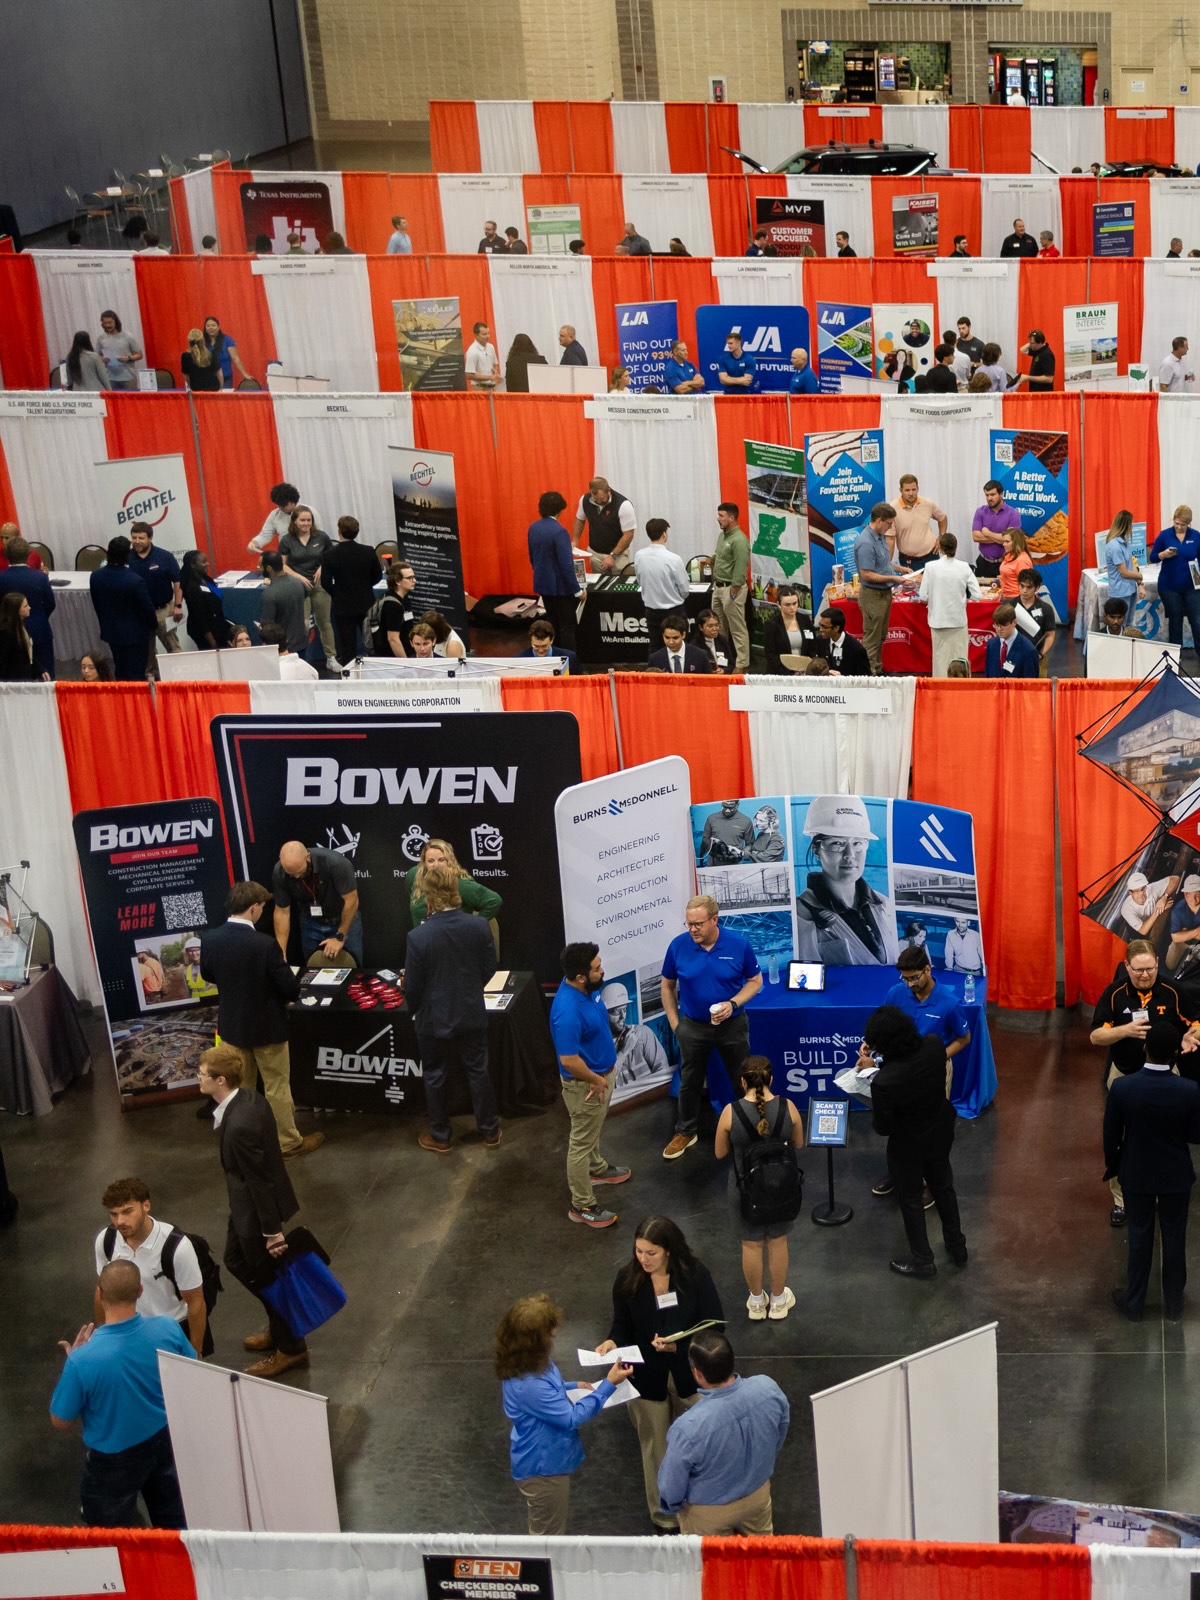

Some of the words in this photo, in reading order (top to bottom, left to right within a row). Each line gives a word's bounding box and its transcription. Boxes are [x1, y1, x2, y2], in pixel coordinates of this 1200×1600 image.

[259, 190, 278, 199] TEXAS
[280, 191, 322, 199] INSTRUMENTS
[785, 205, 811, 214] MVP
[770, 226, 812, 236] CUSTOMER
[773, 234, 811, 243] FOCUSED.
[427, 305, 454, 313] KELLER
[1075, 309, 1106, 319] BRAUN
[621, 311, 649, 327] LJA
[821, 310, 846, 326] LJA
[1075, 318, 1106, 328] INTERTEC
[623, 340, 648, 351] FIND
[649, 338, 673, 349] OUT
[623, 352, 649, 363] WHY
[821, 357, 853, 366] ENGINEERING
[625, 365, 640, 374] OF
[642, 362, 666, 372] OUR
[607, 406, 627, 414] MESSER
[909, 407, 925, 415] MCKEE
[941, 406, 972, 416] CORPORATION
[409, 467, 436, 482] BECHTEL
[837, 467, 852, 477] Join
[1013, 471, 1020, 480] A
[1021, 471, 1047, 482] Better
[829, 475, 863, 486] America's
[819, 485, 848, 495] Favorite
[849, 483, 873, 493] Family
[1016, 481, 1034, 493] Way
[1034, 483, 1044, 492] to
[833, 494, 860, 503] Bakery.
[1002, 490, 1017, 500] Live
[1018, 492, 1034, 501] and
[1035, 493, 1059, 503] Work.
[117, 488, 177, 525] BECHTEL
[405, 520, 436, 532] Extraordinary
[399, 527, 418, 536] building
[417, 529, 438, 539] inspiring
[437, 532, 458, 541] projects.
[337, 698, 363, 707] BOWEN
[364, 698, 411, 707] ENGINEERING
[411, 697, 461, 707] CORPORATION
[774, 695, 798, 704] BURNS
[798, 695, 804, 704] &
[805, 695, 847, 704] MCDONNELL
[284, 762, 518, 811] BOWEN
[573, 806, 607, 825] BURNS
[90, 818, 214, 852] BOWEN
[598, 832, 661, 860] ENGINEERING
[107, 863, 159, 876] CONSTRUCTION
[159, 857, 206, 869] MANAGEMENT
[118, 870, 161, 881] MECHANICAL
[161, 864, 198, 875] ENGINEERS
[472, 868, 509, 877] Results.
[596, 853, 666, 884] ARCHITECTURE
[132, 878, 149, 887] CIVIL
[150, 873, 186, 884] ENGINEERS
[125, 883, 164, 894] CORPORATE
[165, 879, 195, 889] SERVICES
[597, 875, 669, 906] CONSTRUCTION
[117, 902, 156, 919] LEARN
[595, 895, 673, 929] ENVIRONMENTAL
[119, 915, 156, 932] MORE
[607, 919, 666, 946] CONSULTING
[1157, 1004, 1167, 1015] T
[800, 1036, 831, 1044] BURNS
[316, 1046, 423, 1078] BOWEN
[784, 1050, 849, 1066] BUILD
[475, 1561, 521, 1576] TEN
[440, 1580, 540, 1593] CHECKERBOARD
[464, 1590, 517, 1600] MEMBER
